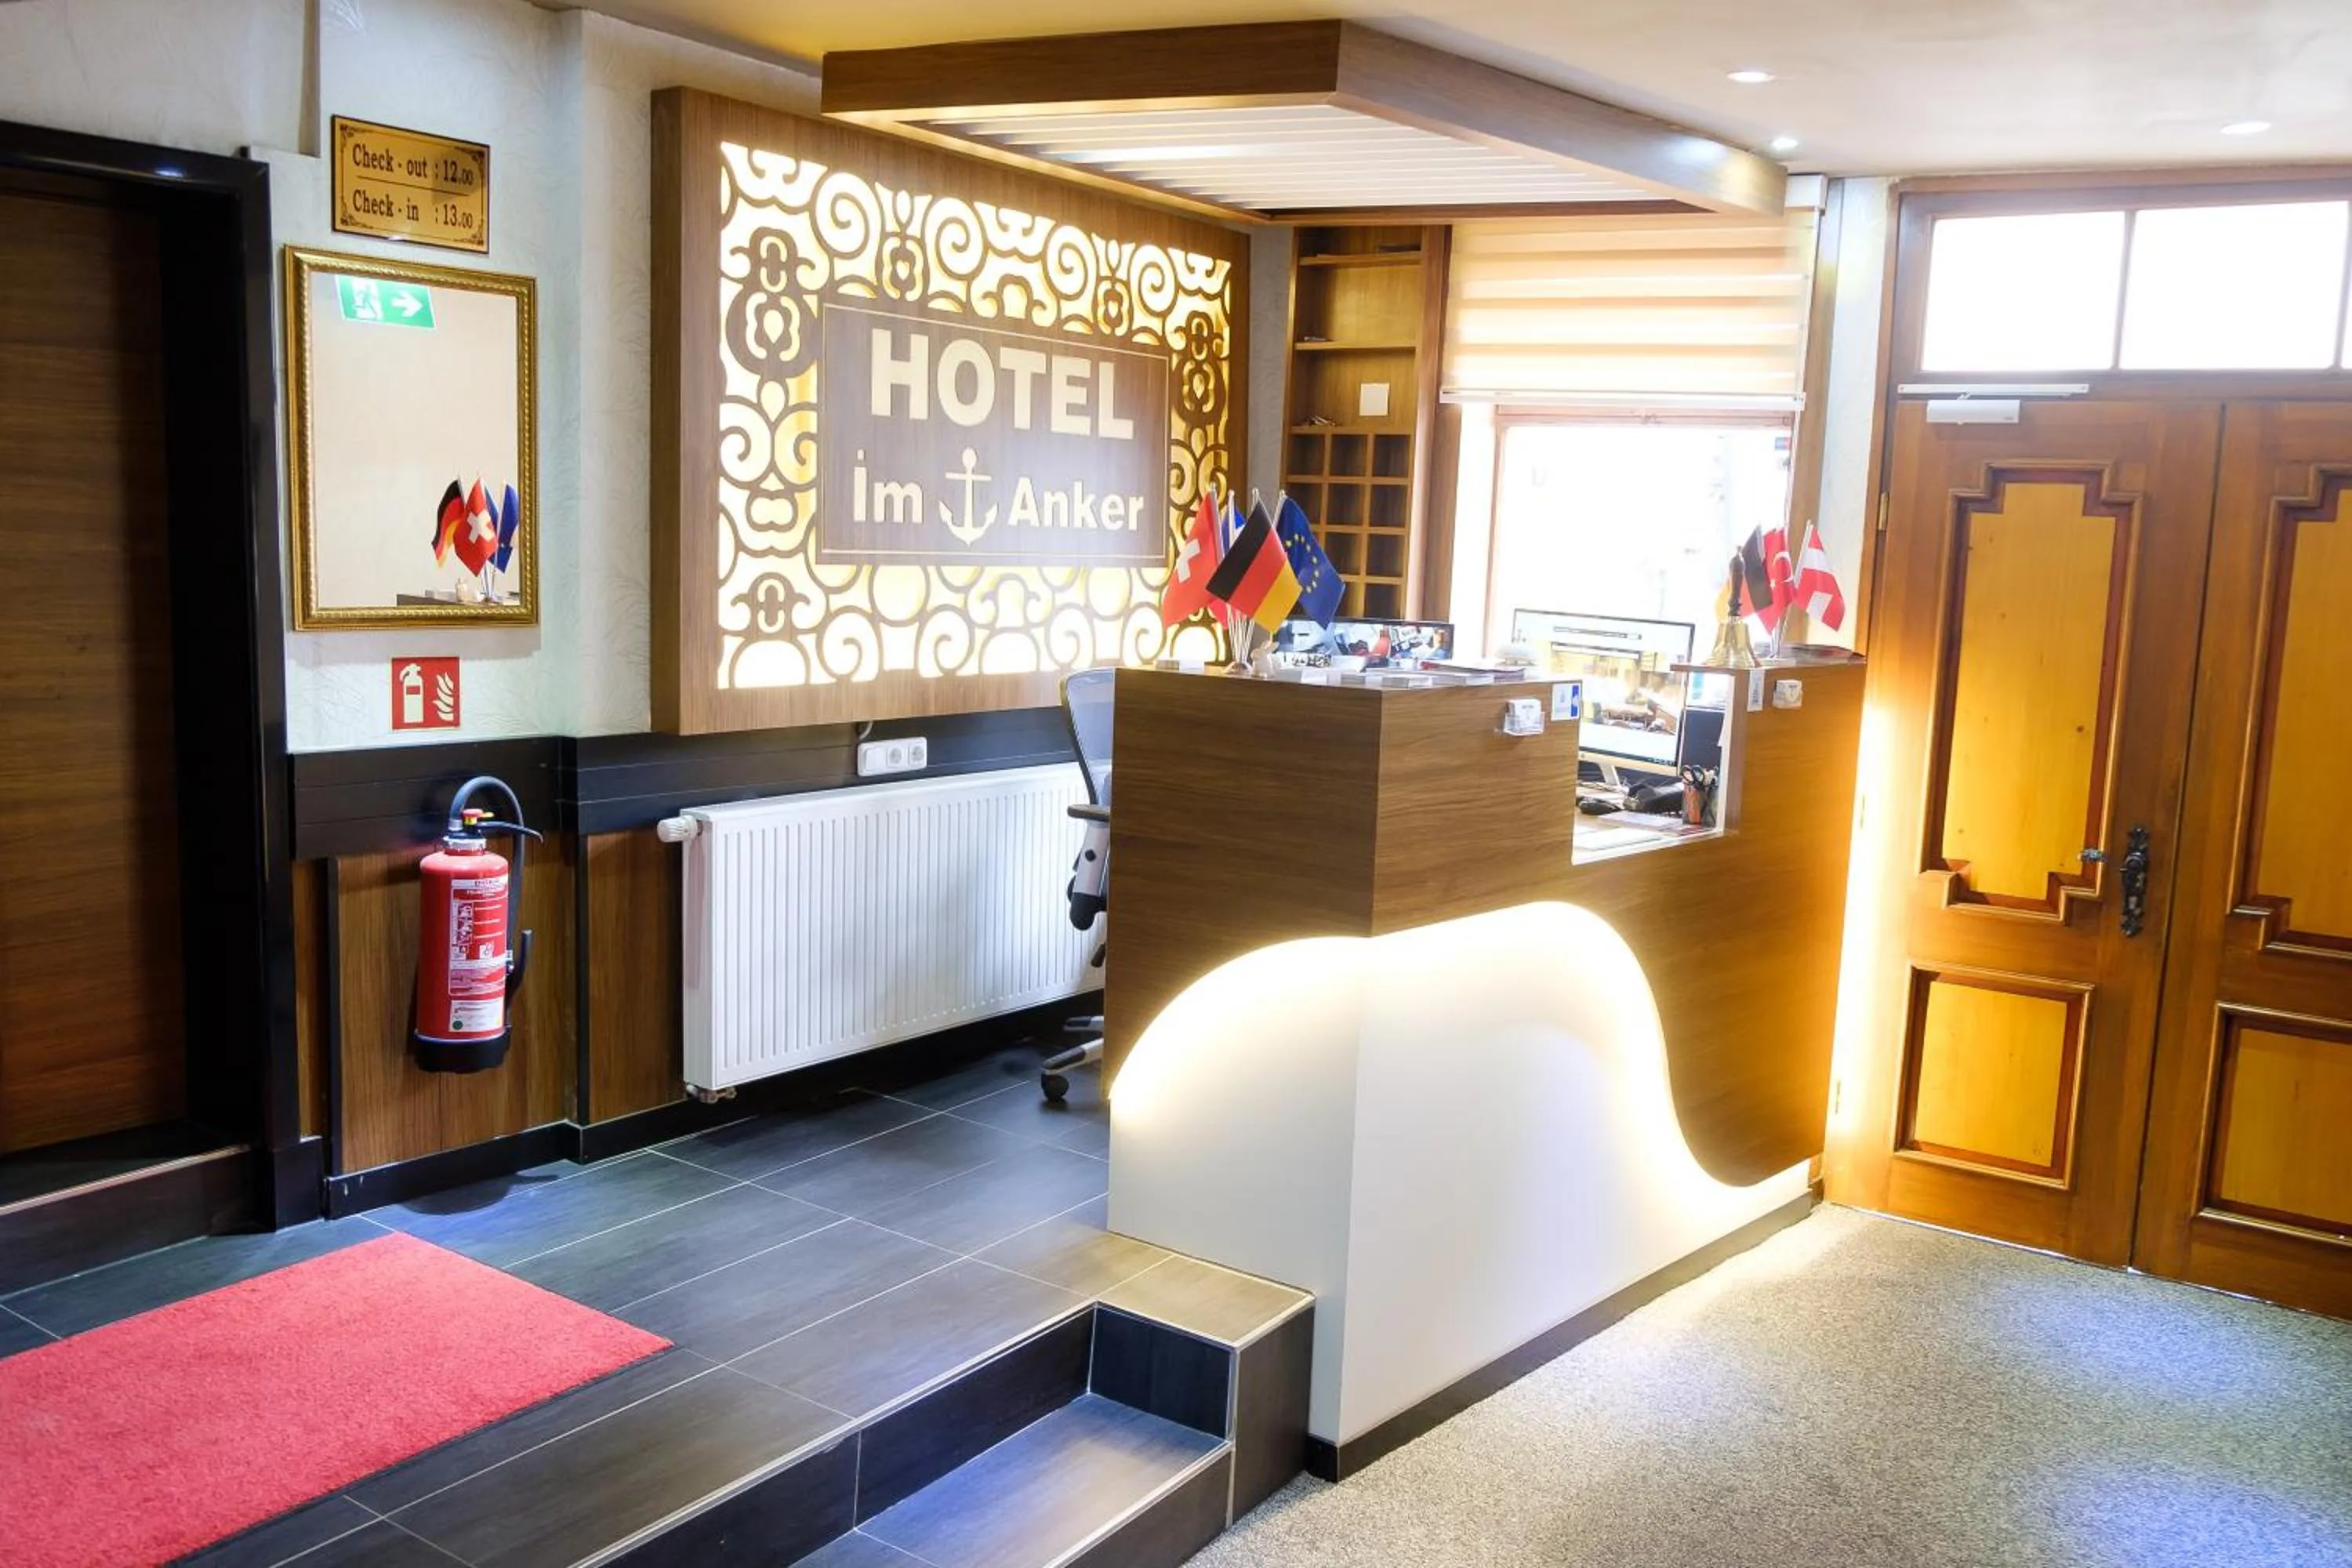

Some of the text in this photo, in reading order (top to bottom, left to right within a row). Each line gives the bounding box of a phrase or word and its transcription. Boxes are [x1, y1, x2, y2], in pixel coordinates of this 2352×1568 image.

[352, 143, 394, 172] Check
[407, 159, 427, 178] out
[443, 160, 474, 186] 12.00
[352, 189, 394, 217] Check
[407, 197, 419, 221] in
[443, 204, 473, 229] 13.00
[871, 328, 1134, 440] HOTEL
[1007, 477, 1144, 532] Anker
